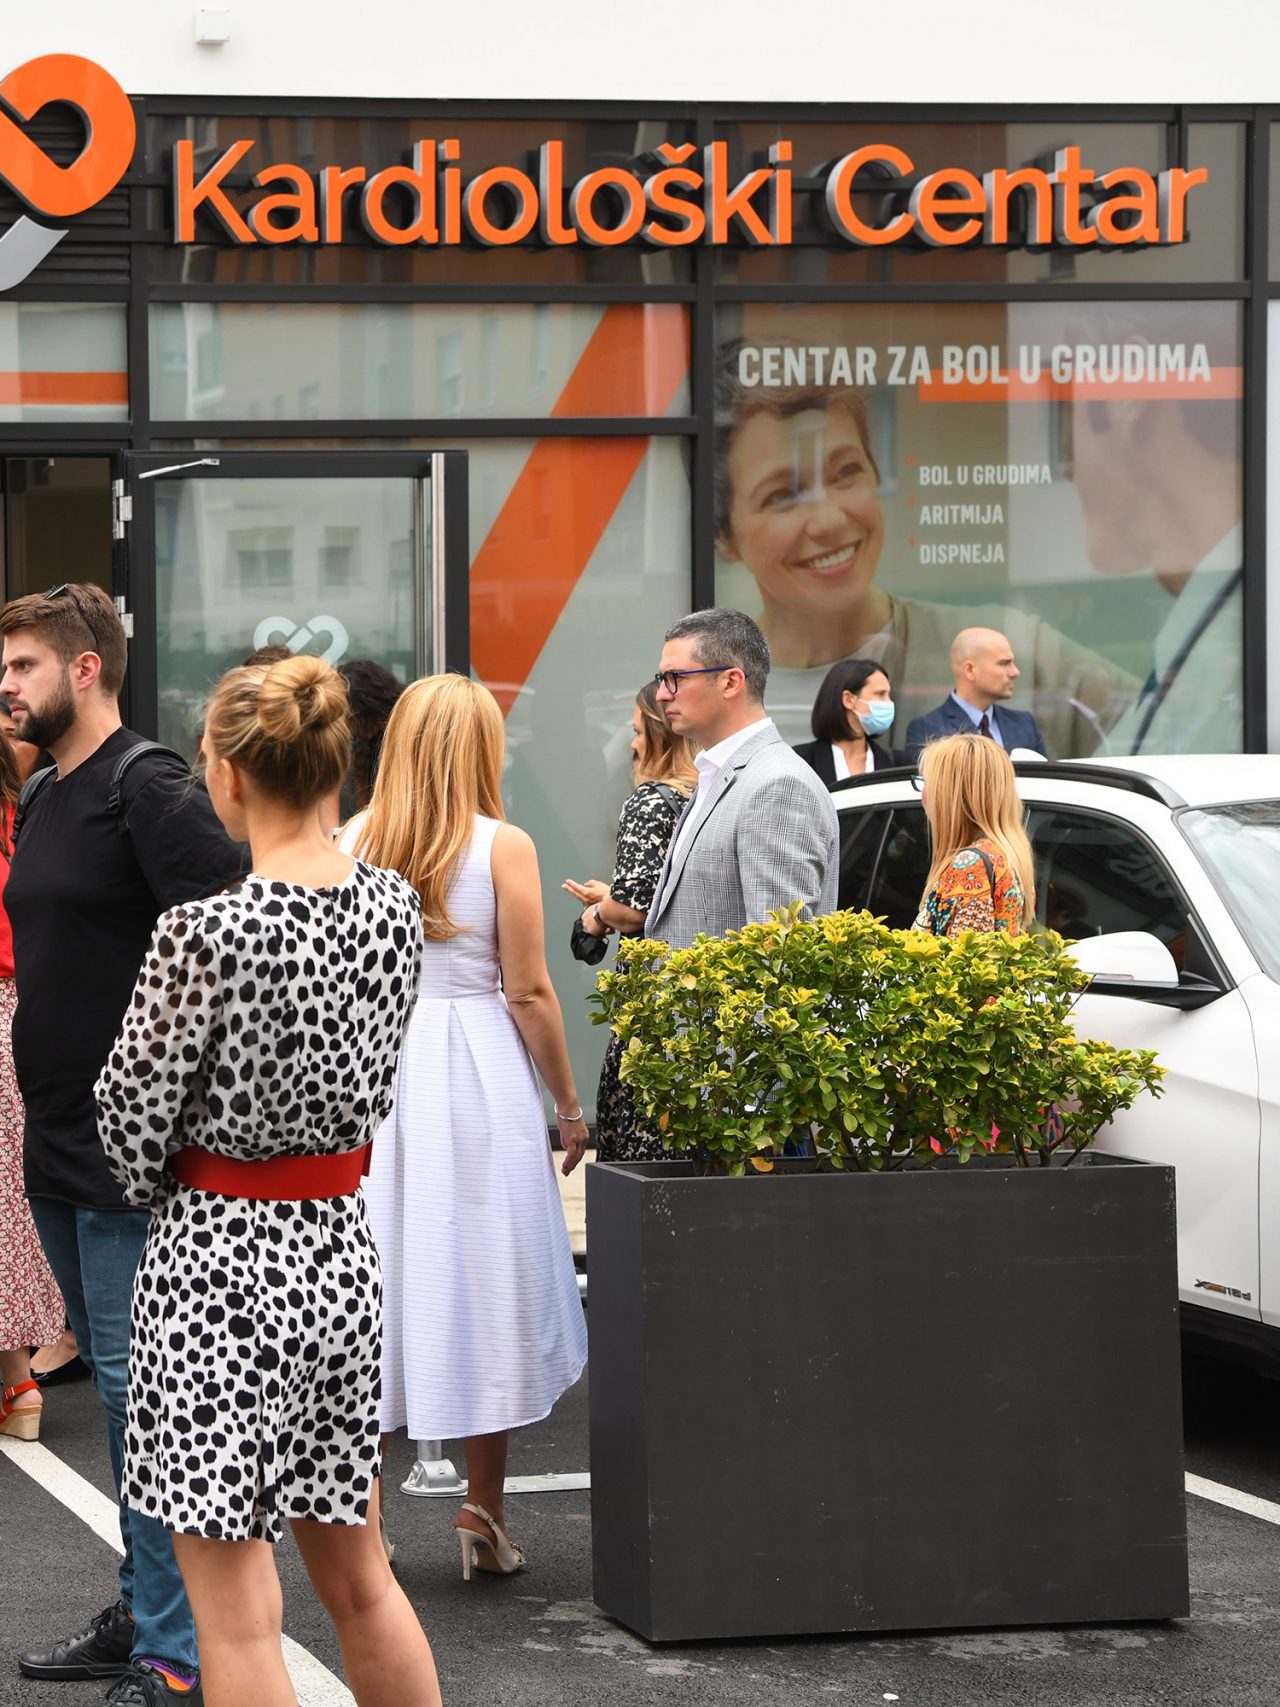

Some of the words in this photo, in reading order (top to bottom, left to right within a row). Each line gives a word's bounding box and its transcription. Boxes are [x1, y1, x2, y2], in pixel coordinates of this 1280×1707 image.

[174, 139, 793, 246] Kardiološki
[827, 143, 1209, 246] Centar
[737, 345, 878, 388] CENTAR
[886, 345, 933, 386] ZA
[942, 344, 1009, 385] BOL
[1019, 344, 1041, 385] U
[1050, 343, 1213, 385] GRUDIMA
[919, 464, 953, 487] BOL
[956, 464, 969, 486] U
[972, 463, 1053, 486] GRUDIMA
[919, 503, 1005, 526] ARITMIJA
[919, 542, 1006, 566] DISPNEJA
